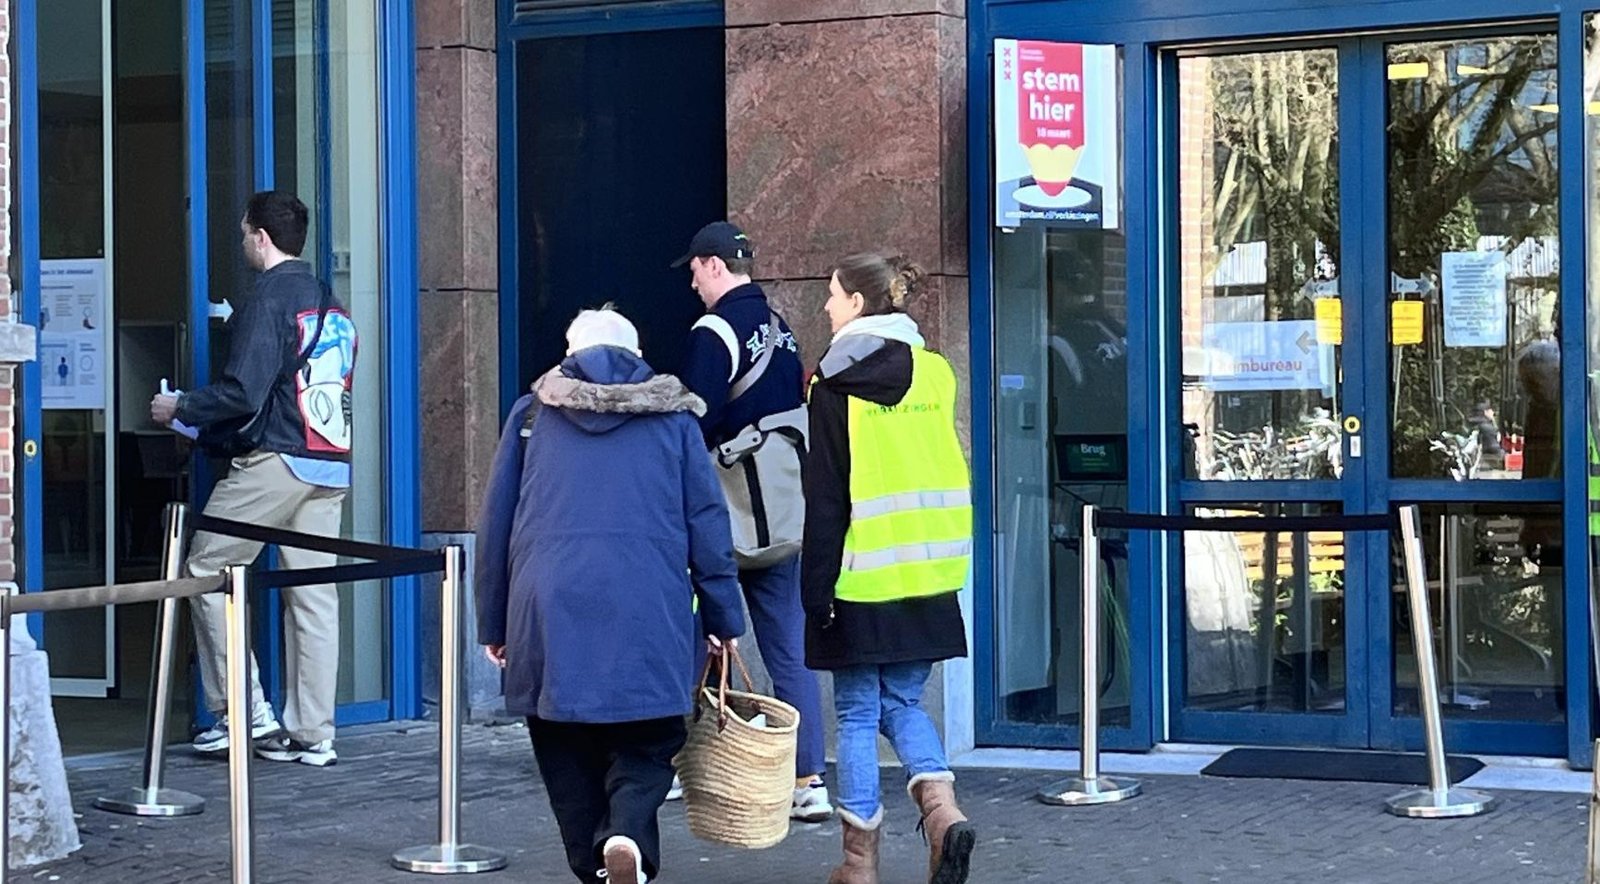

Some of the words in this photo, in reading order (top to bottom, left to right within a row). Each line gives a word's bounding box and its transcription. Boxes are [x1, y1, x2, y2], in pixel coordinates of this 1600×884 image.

[1022, 67, 1081, 92] stem
[1029, 93, 1075, 122] hier
[1080, 443, 1106, 457] Brug
